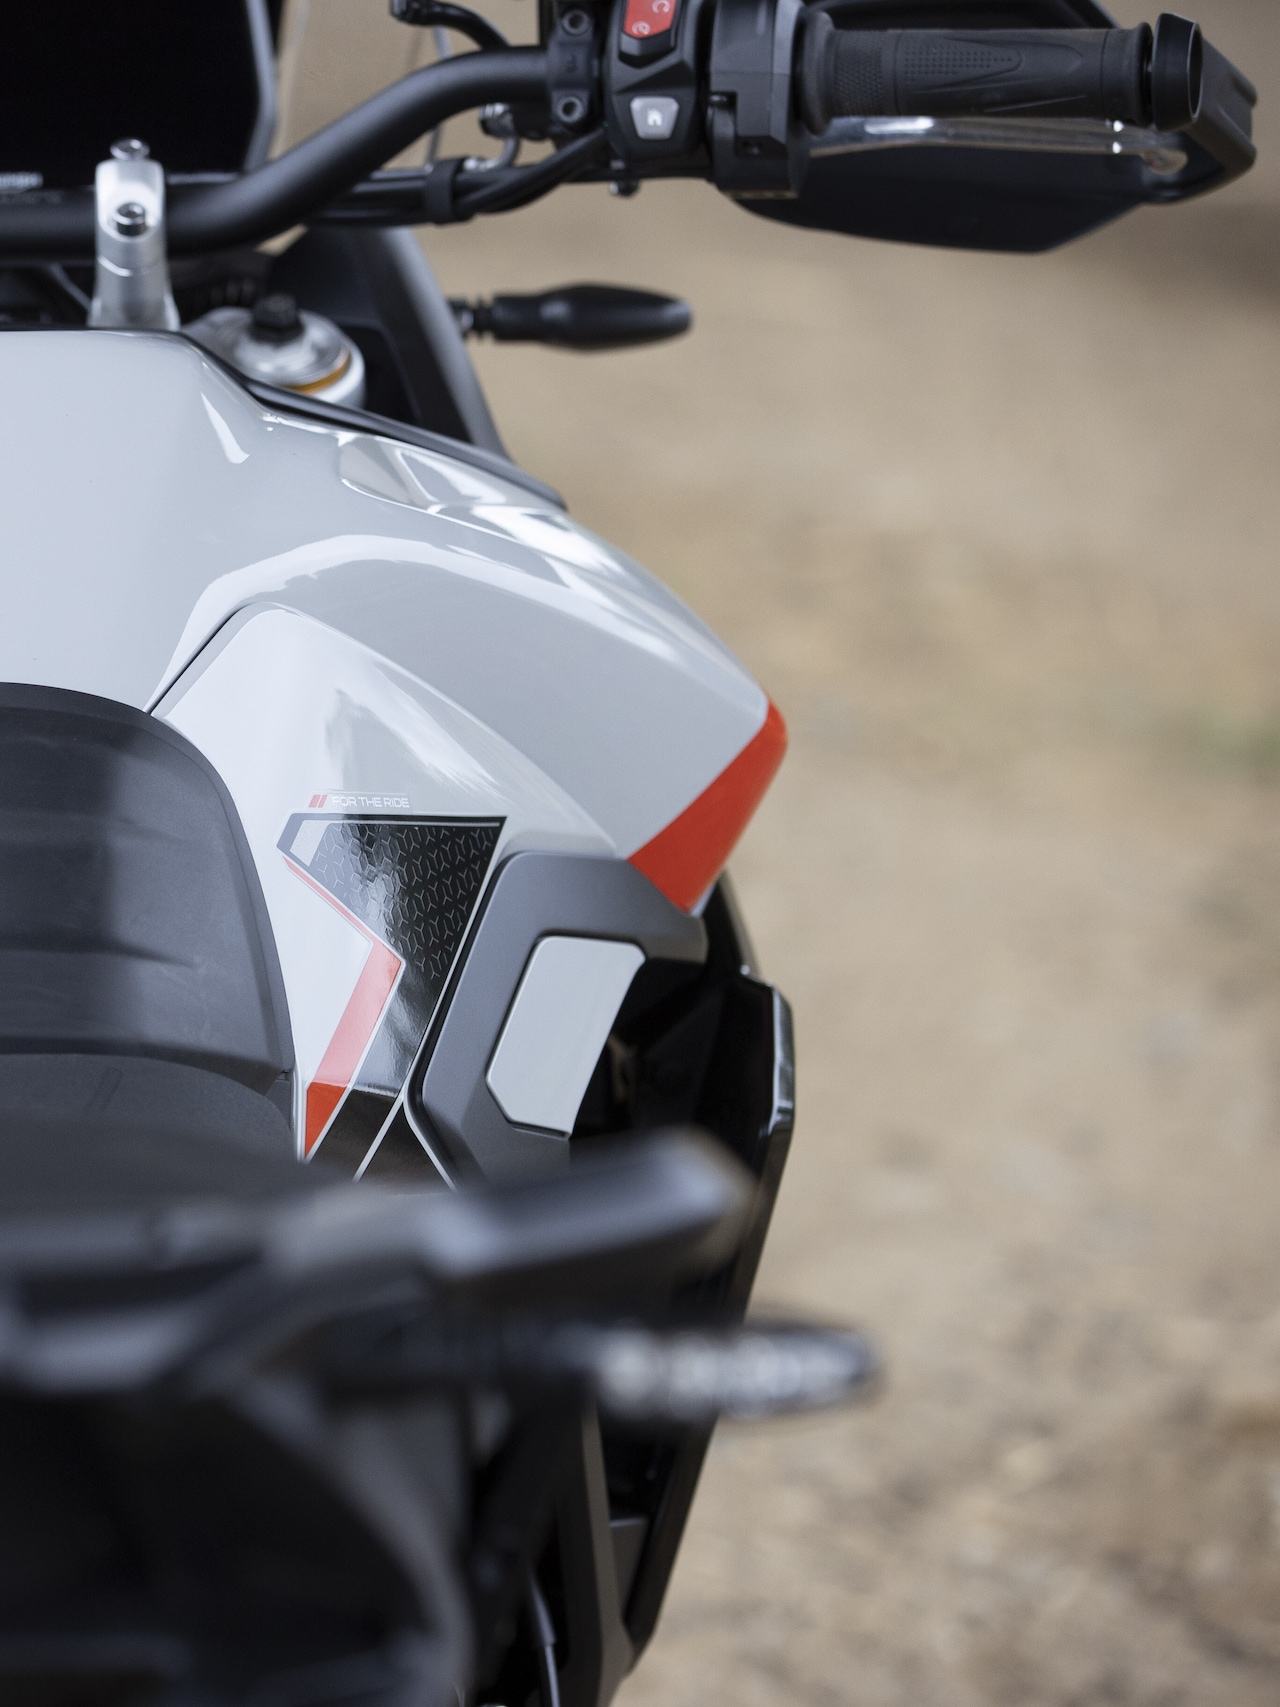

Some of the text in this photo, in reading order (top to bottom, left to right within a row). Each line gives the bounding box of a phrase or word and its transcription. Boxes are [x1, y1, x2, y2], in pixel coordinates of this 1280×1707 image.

[332, 796, 410, 808] FOR THE RIDE
